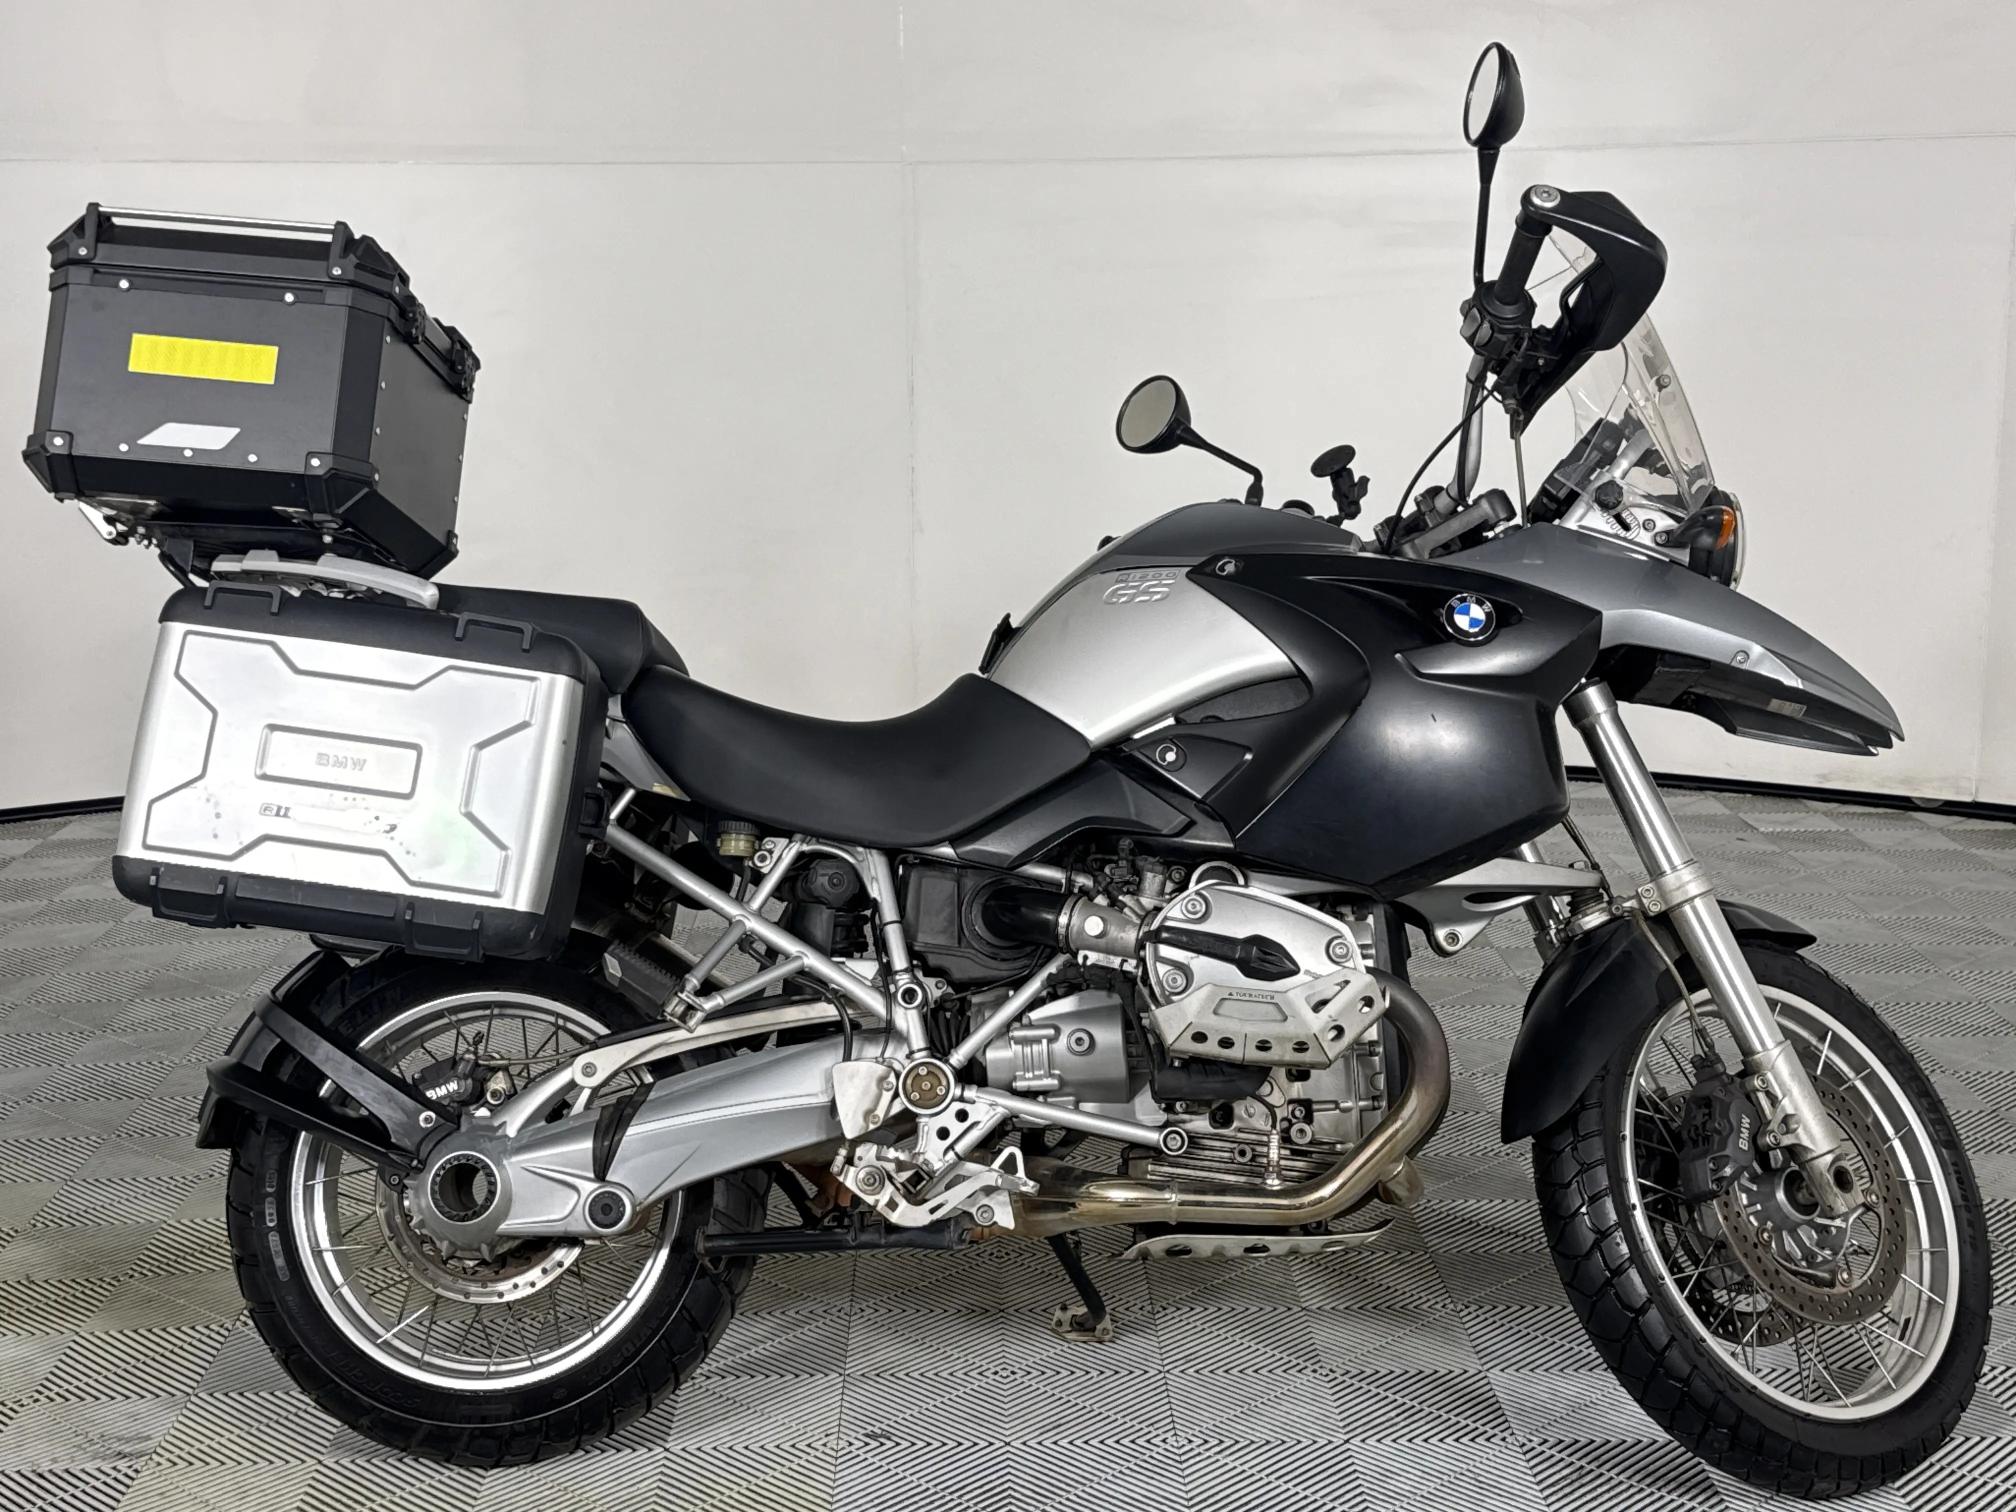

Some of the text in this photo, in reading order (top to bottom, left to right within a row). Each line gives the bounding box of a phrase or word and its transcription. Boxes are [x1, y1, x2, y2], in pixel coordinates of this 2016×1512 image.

[1104, 580, 1175, 605] GS
[1451, 596, 1491, 612] BMW
[315, 752, 367, 771] BMW
[425, 1079, 458, 1100] BMW
[1738, 1112, 1751, 1152] BMW
